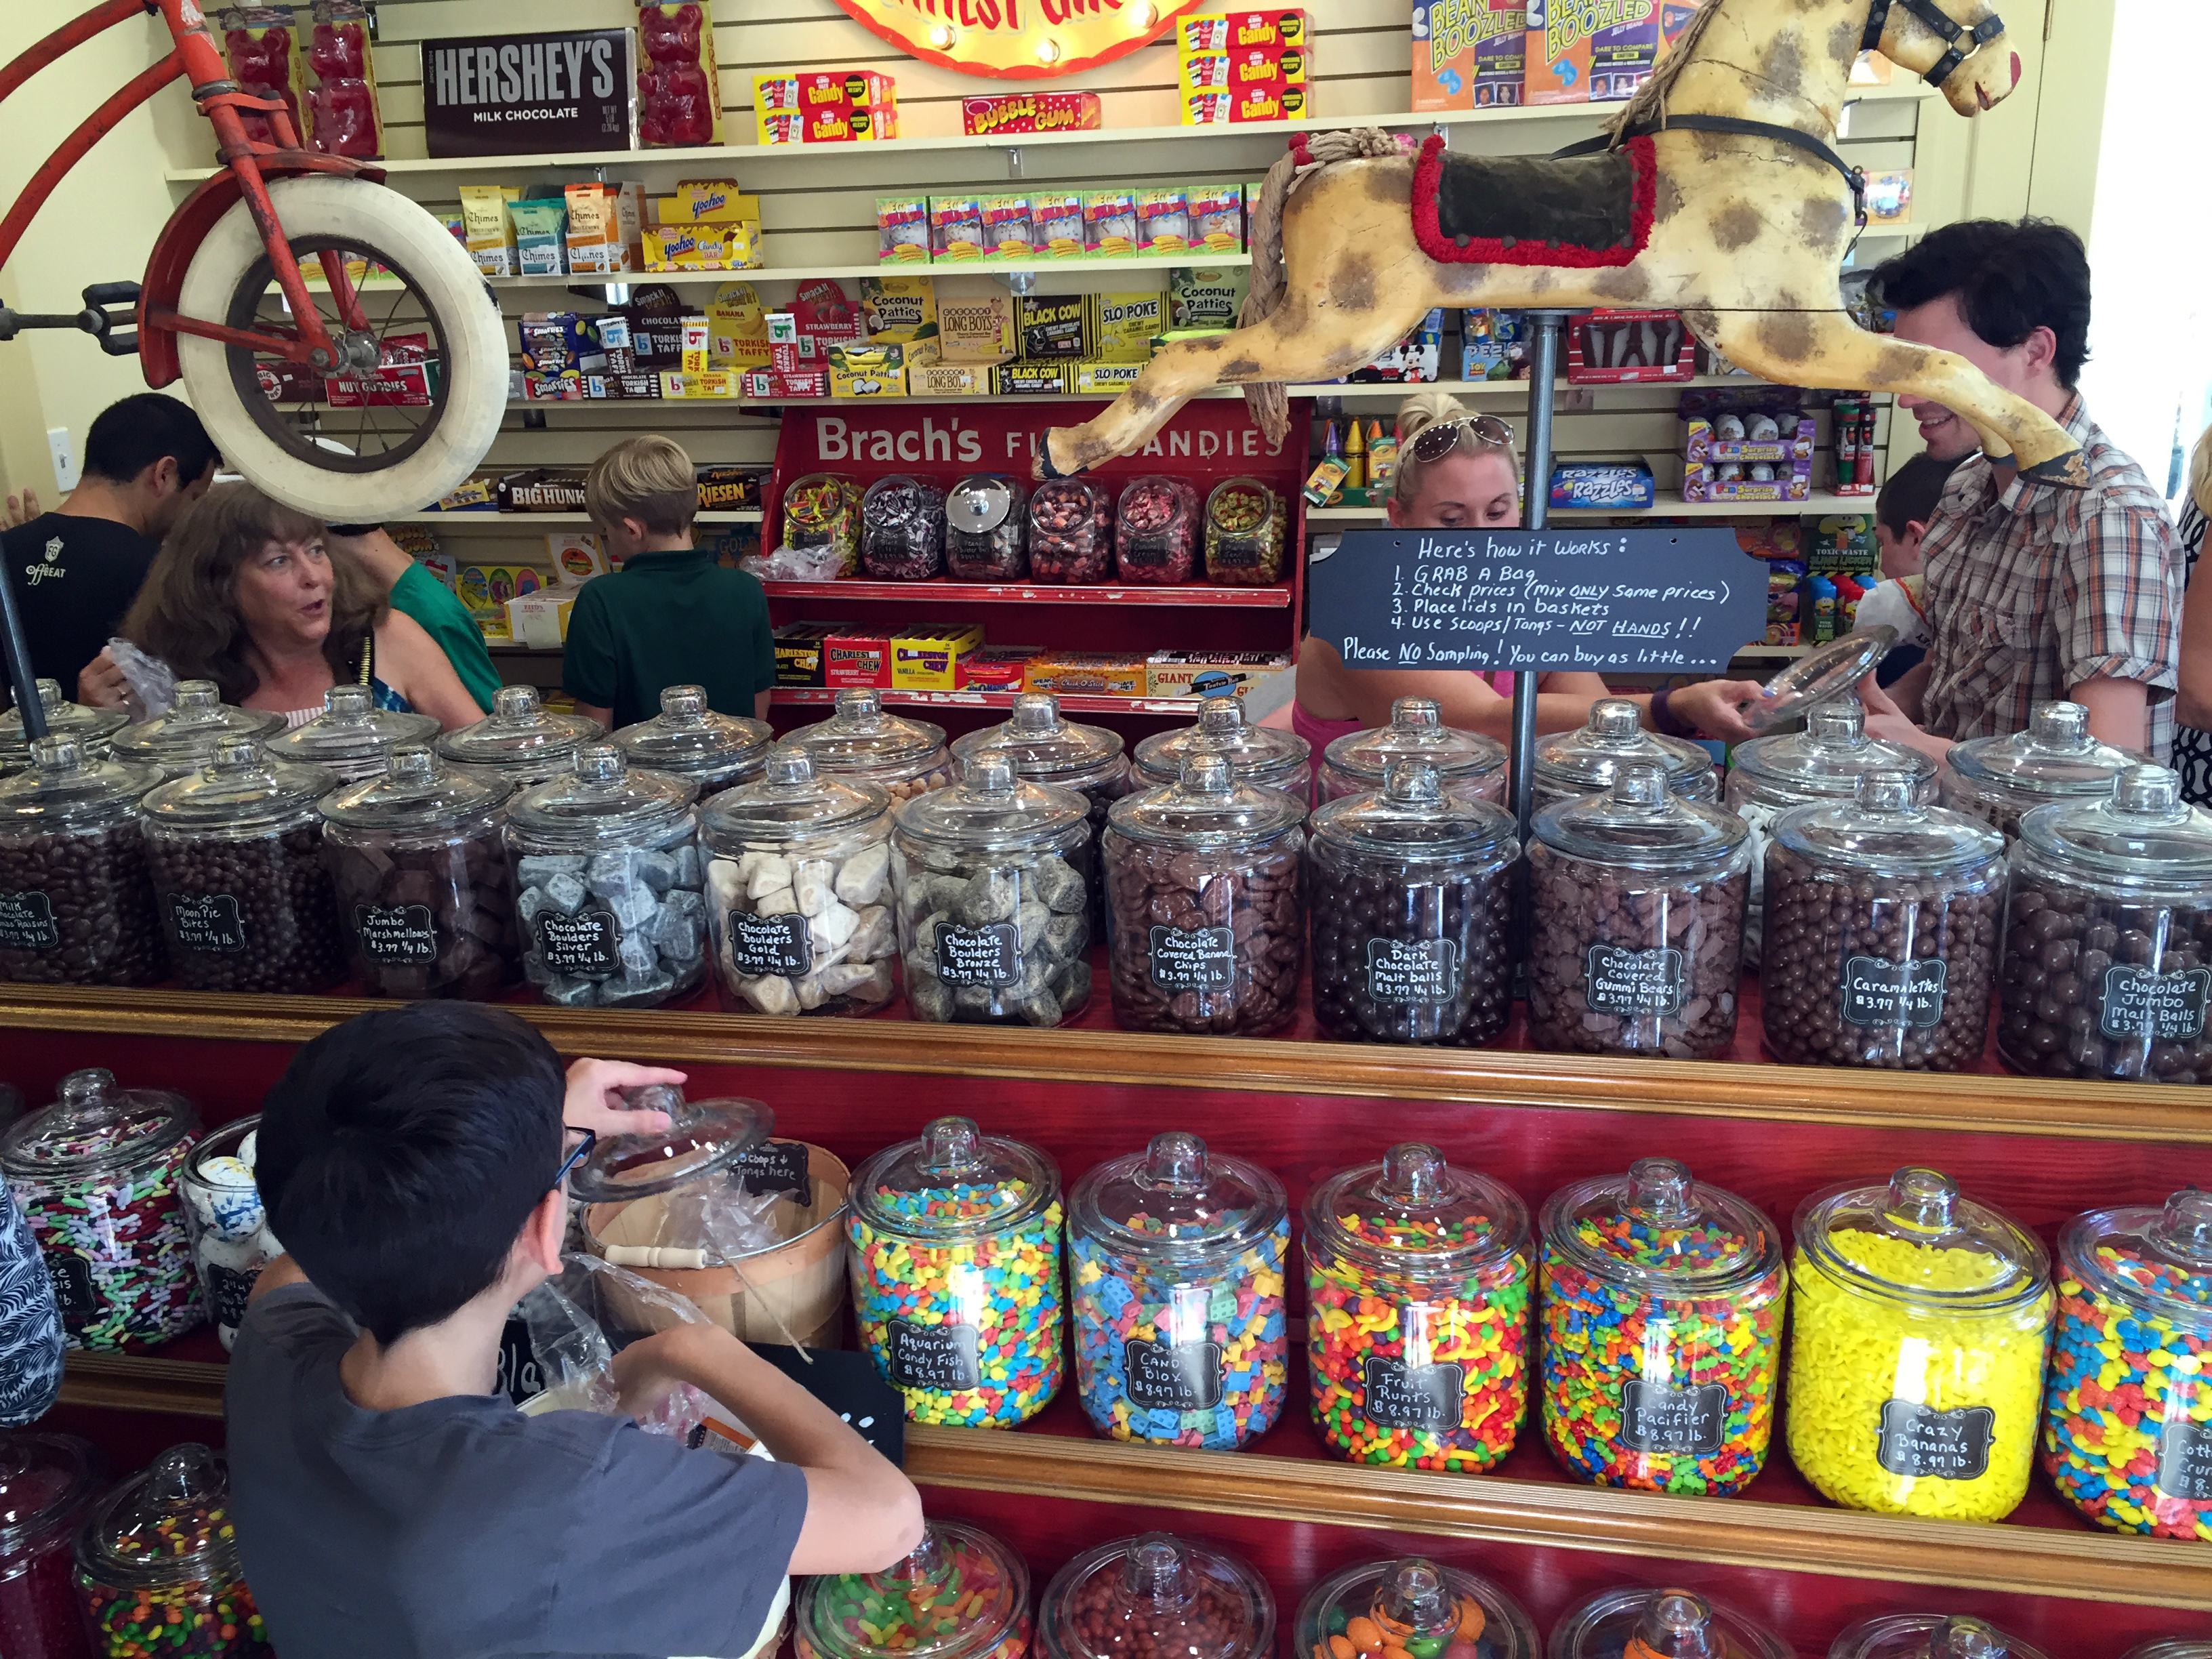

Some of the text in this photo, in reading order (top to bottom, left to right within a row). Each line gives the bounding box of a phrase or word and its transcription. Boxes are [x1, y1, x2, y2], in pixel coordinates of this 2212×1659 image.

[1237, 22, 1276, 45] Candy
[1544, 1, 1651, 65] BOOZLED
[434, 39, 613, 106] HERSHEY'S
[1239, 60, 1278, 83] Candy
[808, 83, 843, 104] Candy
[473, 108, 578, 122] MILK CHOCOLATE
[1241, 97, 1279, 119] Candy
[973, 98, 1074, 134] BUBBLE GUM
[813, 118, 848, 139] Candy
[468, 212, 499, 224] Chimes
[571, 209, 600, 220] Chimes
[522, 249, 556, 262] Chimes
[1181, 287, 1236, 298] Coconut
[872, 296, 924, 307] Coconut
[878, 307, 922, 323] Patties
[1023, 303, 1081, 327] BLACK COW
[1103, 301, 1158, 324] SLO POKE
[943, 315, 992, 331] LONG BOYS
[739, 348, 769, 356] TAFFY
[1466, 343, 1507, 358] PEZ
[836, 369, 867, 380] Coconut
[1012, 368, 1058, 379] BLACK COW
[1094, 369, 1138, 379] SLO POKE
[339, 381, 359, 393] NUT
[927, 376, 945, 388] LONG
[816, 417, 982, 462] Brach's
[1719, 445, 1778, 454] Fun Surprise
[511, 485, 586, 505] BIG HUNK
[1716, 484, 1774, 493] Fun Surprise
[1418, 537, 1475, 559] Here's
[1486, 536, 1521, 558] how
[1529, 539, 1547, 555] it
[1395, 565, 1535, 586] 1. GRAB A Bag
[1392, 583, 1408, 596] 2.
[1411, 583, 1462, 597] Check
[1468, 583, 1515, 602] prices
[1570, 585, 1610, 600] ONLY
[1392, 597, 1610, 616] 3. Place lids in baskets
[1391, 616, 1406, 630] 4.
[1412, 616, 1441, 630] Use
[1569, 619, 1607, 632] NOT
[1612, 620, 1671, 636] HANDS
[1344, 636, 1391, 661] Please
[1399, 643, 1421, 661] NO
[1509, 645, 1536, 665] You
[1541, 651, 1569, 662] can
[1574, 645, 1605, 666] buy
[1607, 652, 1628, 663] as
[1637, 649, 1685, 663] little
[857, 661, 881, 673] CHEW
[923, 661, 948, 674] CHEW
[1158, 673, 1193, 684] GIANT
[176, 905, 221, 918] Moon Pie
[14, 918, 47, 928] Raisins
[180, 917, 209, 928] Bites
[367, 915, 405, 926] Jumbo
[545, 920, 603, 932] Chocolate
[363, 927, 430, 940] Marshmellows
[738, 922, 790, 935] Chocolate
[548, 931, 599, 941] Boulders
[741, 933, 792, 944] Boulders
[945, 933, 1002, 947] Chocolate
[1166, 936, 1218, 949] Chocolate
[556, 941, 592, 951] Silver
[749, 944, 780, 955] Gold
[948, 945, 1000, 958] Boulders
[1157, 948, 1232, 960] Covered Banana
[1391, 949, 1428, 960] Dark
[1174, 960, 1206, 971] Chips
[1376, 958, 1438, 970] Chocolate
[1601, 956, 1666, 971] Chocolate
[1410, 971, 1442, 983] balls
[1608, 969, 1666, 982] Covered
[1595, 977, 1673, 995] Gummi Bears
[2119, 977, 2196, 995] Chocolate
[1917, 998, 1931, 1008] lb.
[2122, 994, 2184, 1008] Jumbo
[2160, 1009, 2195, 1023] Balls
[733, 1165, 796, 1180] Tongs here
[900, 1333, 966, 1351] Aquarium
[898, 1348, 963, 1369] Candy Fish
[1380, 1373, 1427, 1389] Fruit
[1376, 1385, 1431, 1403] Runts
[1648, 1397, 1698, 1416] Candy
[1635, 1407, 1709, 1426] Pacifier
[1906, 1419, 1963, 1441] Crazy
[1895, 1433, 1968, 1453] Bananas
